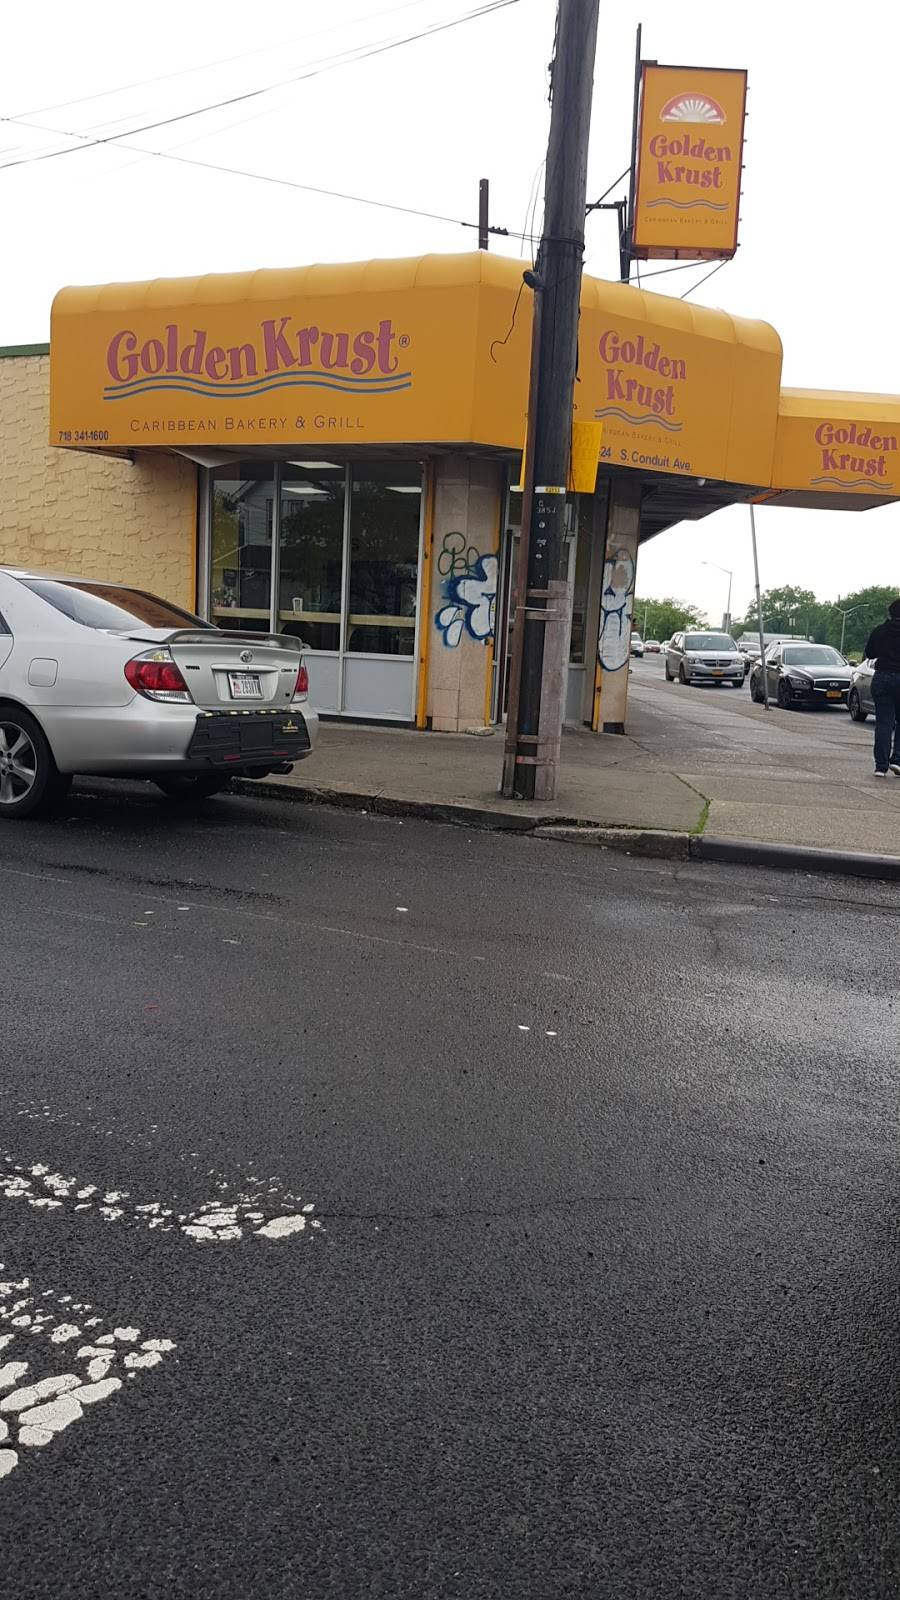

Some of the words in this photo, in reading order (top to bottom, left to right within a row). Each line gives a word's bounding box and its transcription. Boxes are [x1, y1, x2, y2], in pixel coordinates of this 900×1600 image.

[650, 134, 732, 162] Golden
[657, 161, 723, 188] Krust
[106, 324, 258, 382] Golden
[261, 316, 399, 375] Krust
[599, 330, 687, 380] Golden
[606, 368, 676, 415] Krust
[59, 430, 72, 441] 718
[74, 430, 109, 441] 341-1600
[130, 418, 216, 432] CARIBBEAN
[225, 416, 288, 431] BAKERY
[295, 415, 305, 429] &
[314, 414, 364, 429] GRILL
[815, 422, 898, 451] Golden
[631, 450, 669, 469] Conduit
[822, 448, 887, 477] Krust
